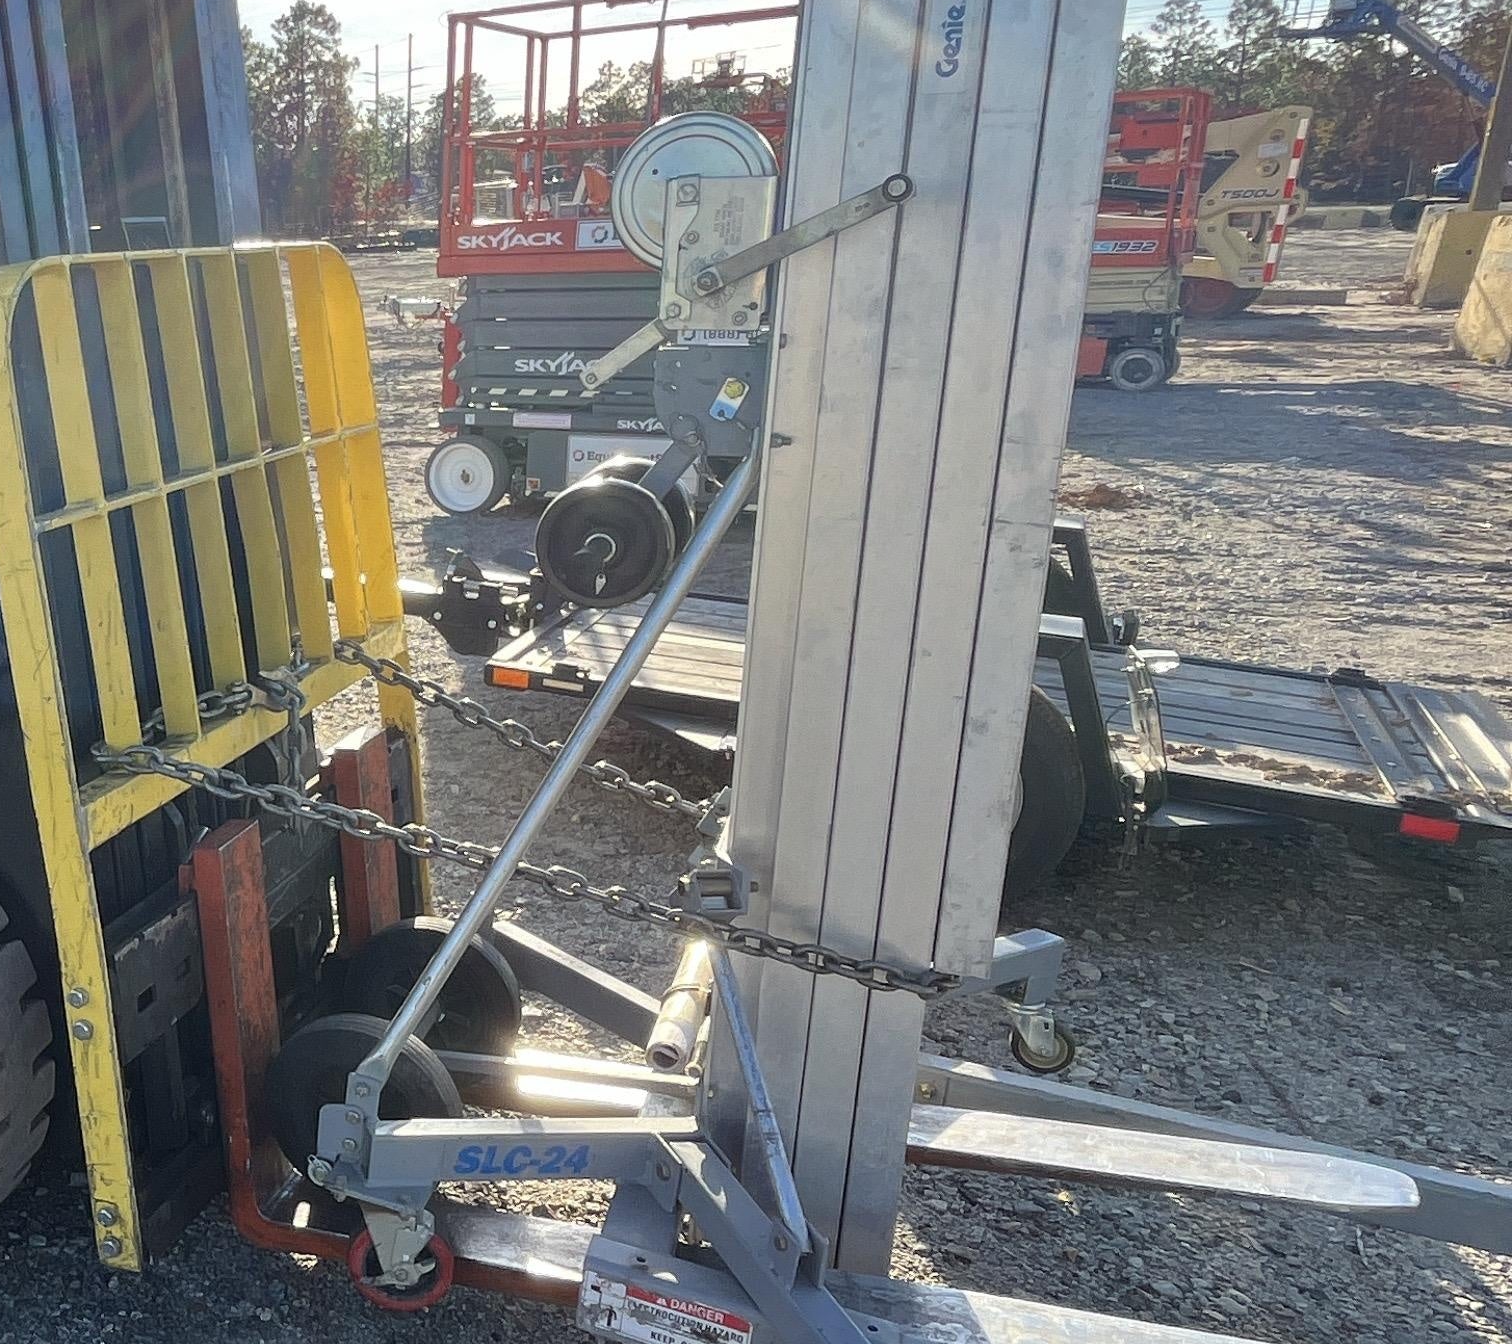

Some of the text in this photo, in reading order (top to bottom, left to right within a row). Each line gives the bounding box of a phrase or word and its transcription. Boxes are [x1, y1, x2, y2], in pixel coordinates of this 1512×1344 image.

[935, 3, 966, 78] Genie
[457, 226, 563, 251] SKYJACK
[514, 351, 594, 375] SKYJA
[617, 417, 665, 432] SKYJA
[454, 1144, 590, 1174] SLC-24
[670, 1298, 725, 1323] DANGER
[650, 1330, 676, 1344] KEEP
